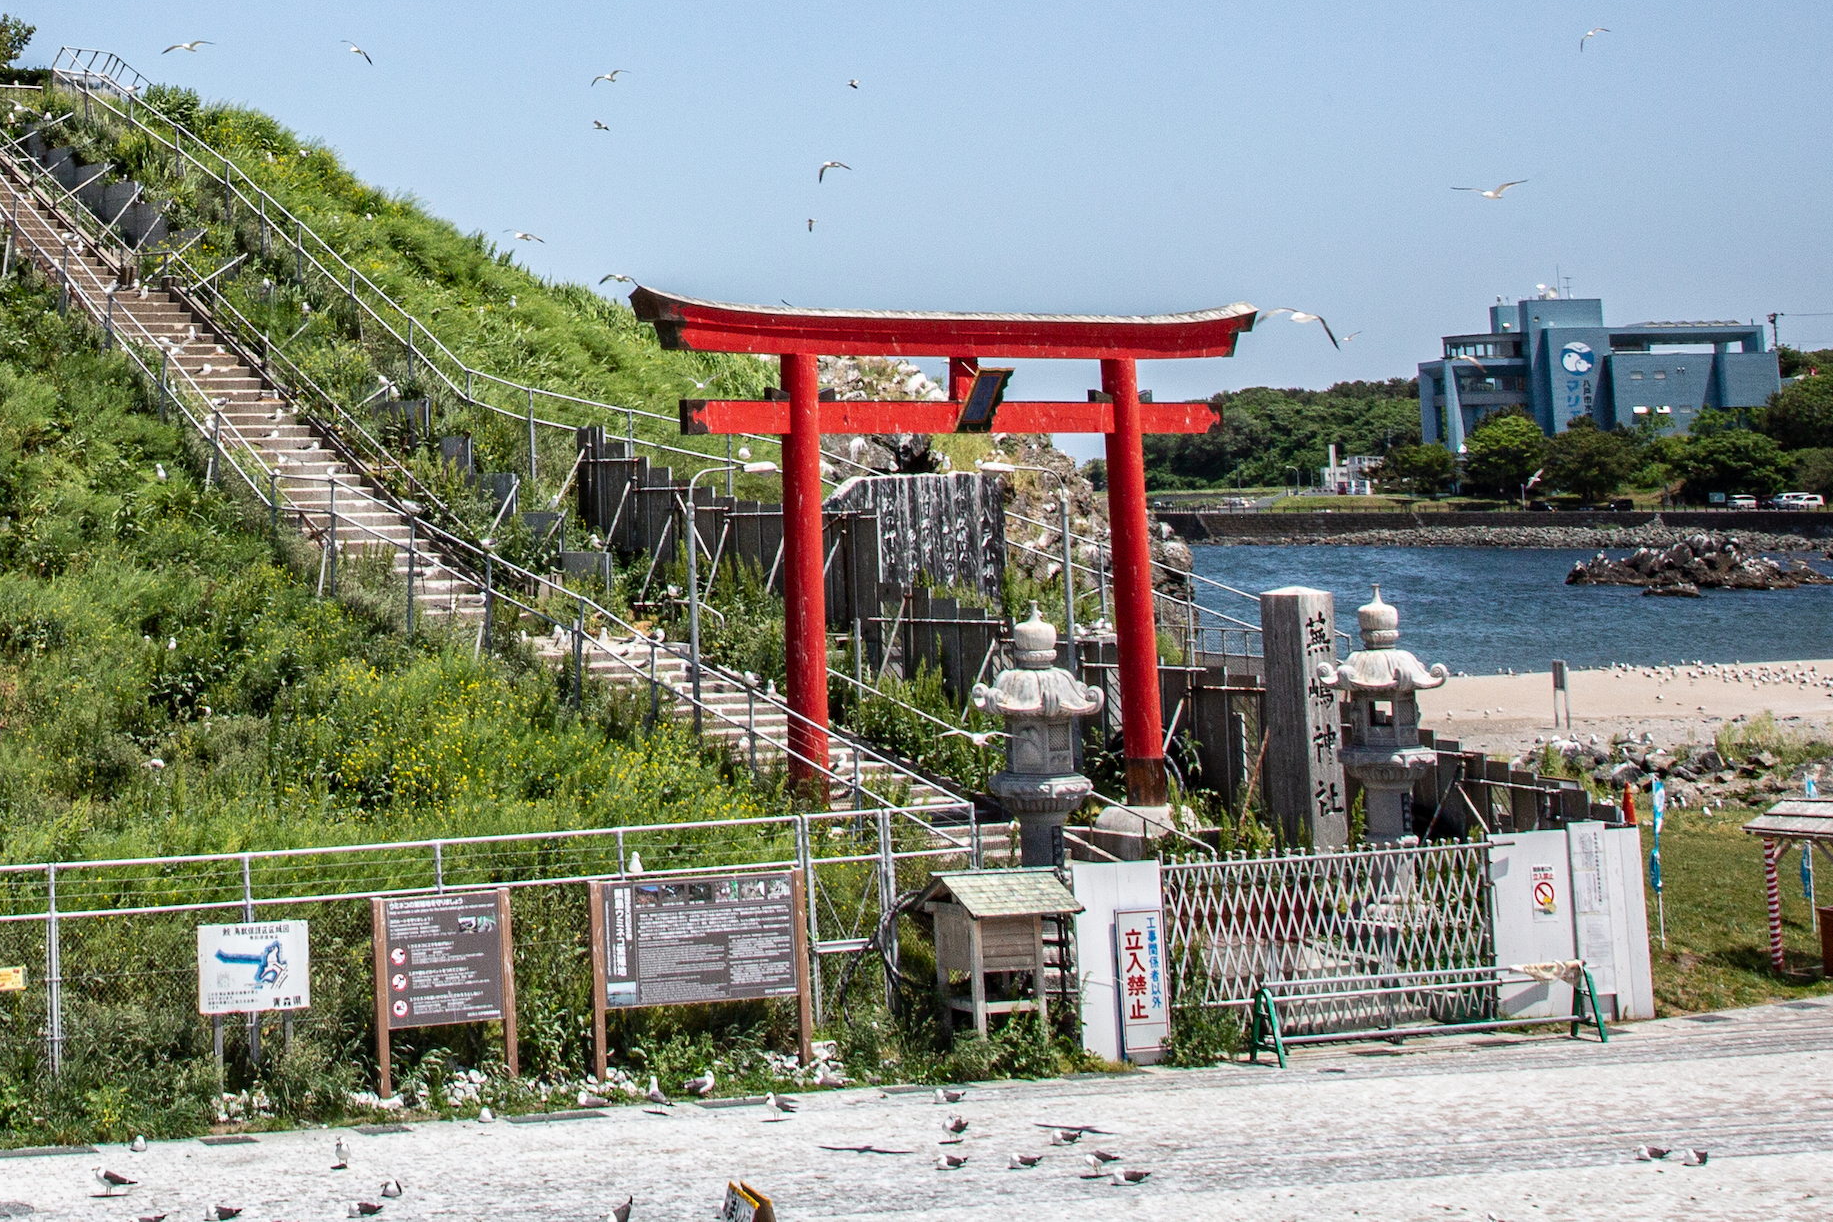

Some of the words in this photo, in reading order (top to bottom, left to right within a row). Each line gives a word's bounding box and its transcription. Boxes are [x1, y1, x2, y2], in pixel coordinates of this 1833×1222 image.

[1532, 872, 1554, 881] 立入禁止
[1125, 928, 1149, 1020] 立入禁止
[1146, 917, 1162, 1009] 工事関係者以外
